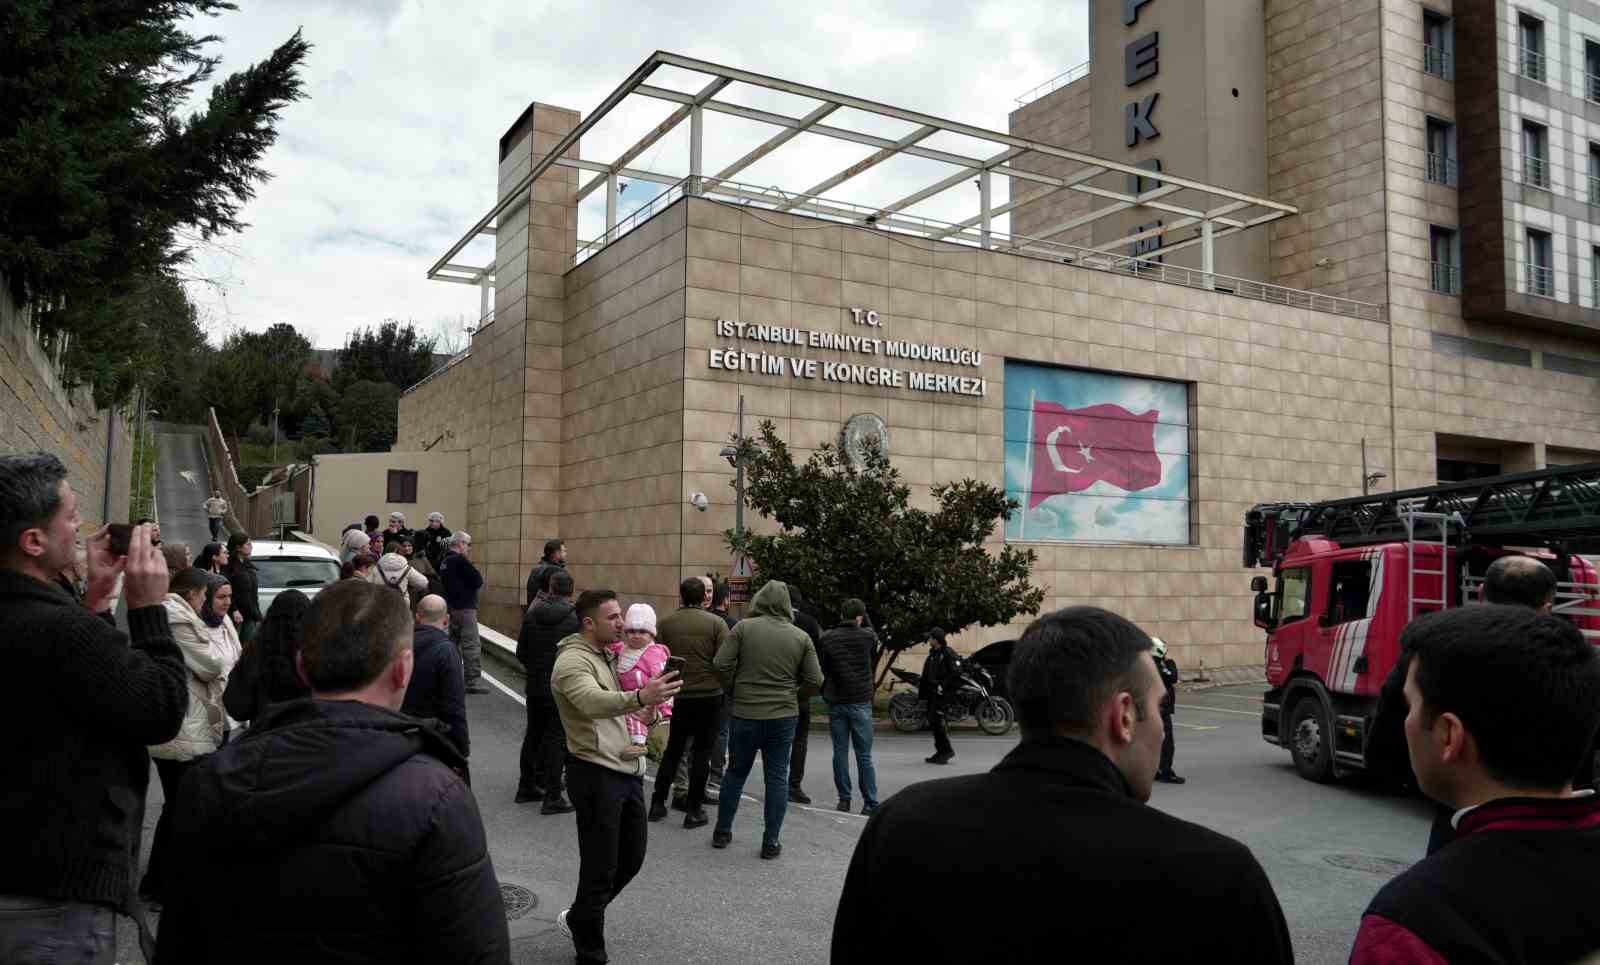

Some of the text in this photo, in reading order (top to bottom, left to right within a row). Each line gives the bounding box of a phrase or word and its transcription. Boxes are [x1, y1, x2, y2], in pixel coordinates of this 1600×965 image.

[850, 307, 883, 327] T.C.
[710, 346, 785, 376] EĞİTİM
[790, 357, 817, 379] VE
[823, 361, 903, 387] KONGRE
